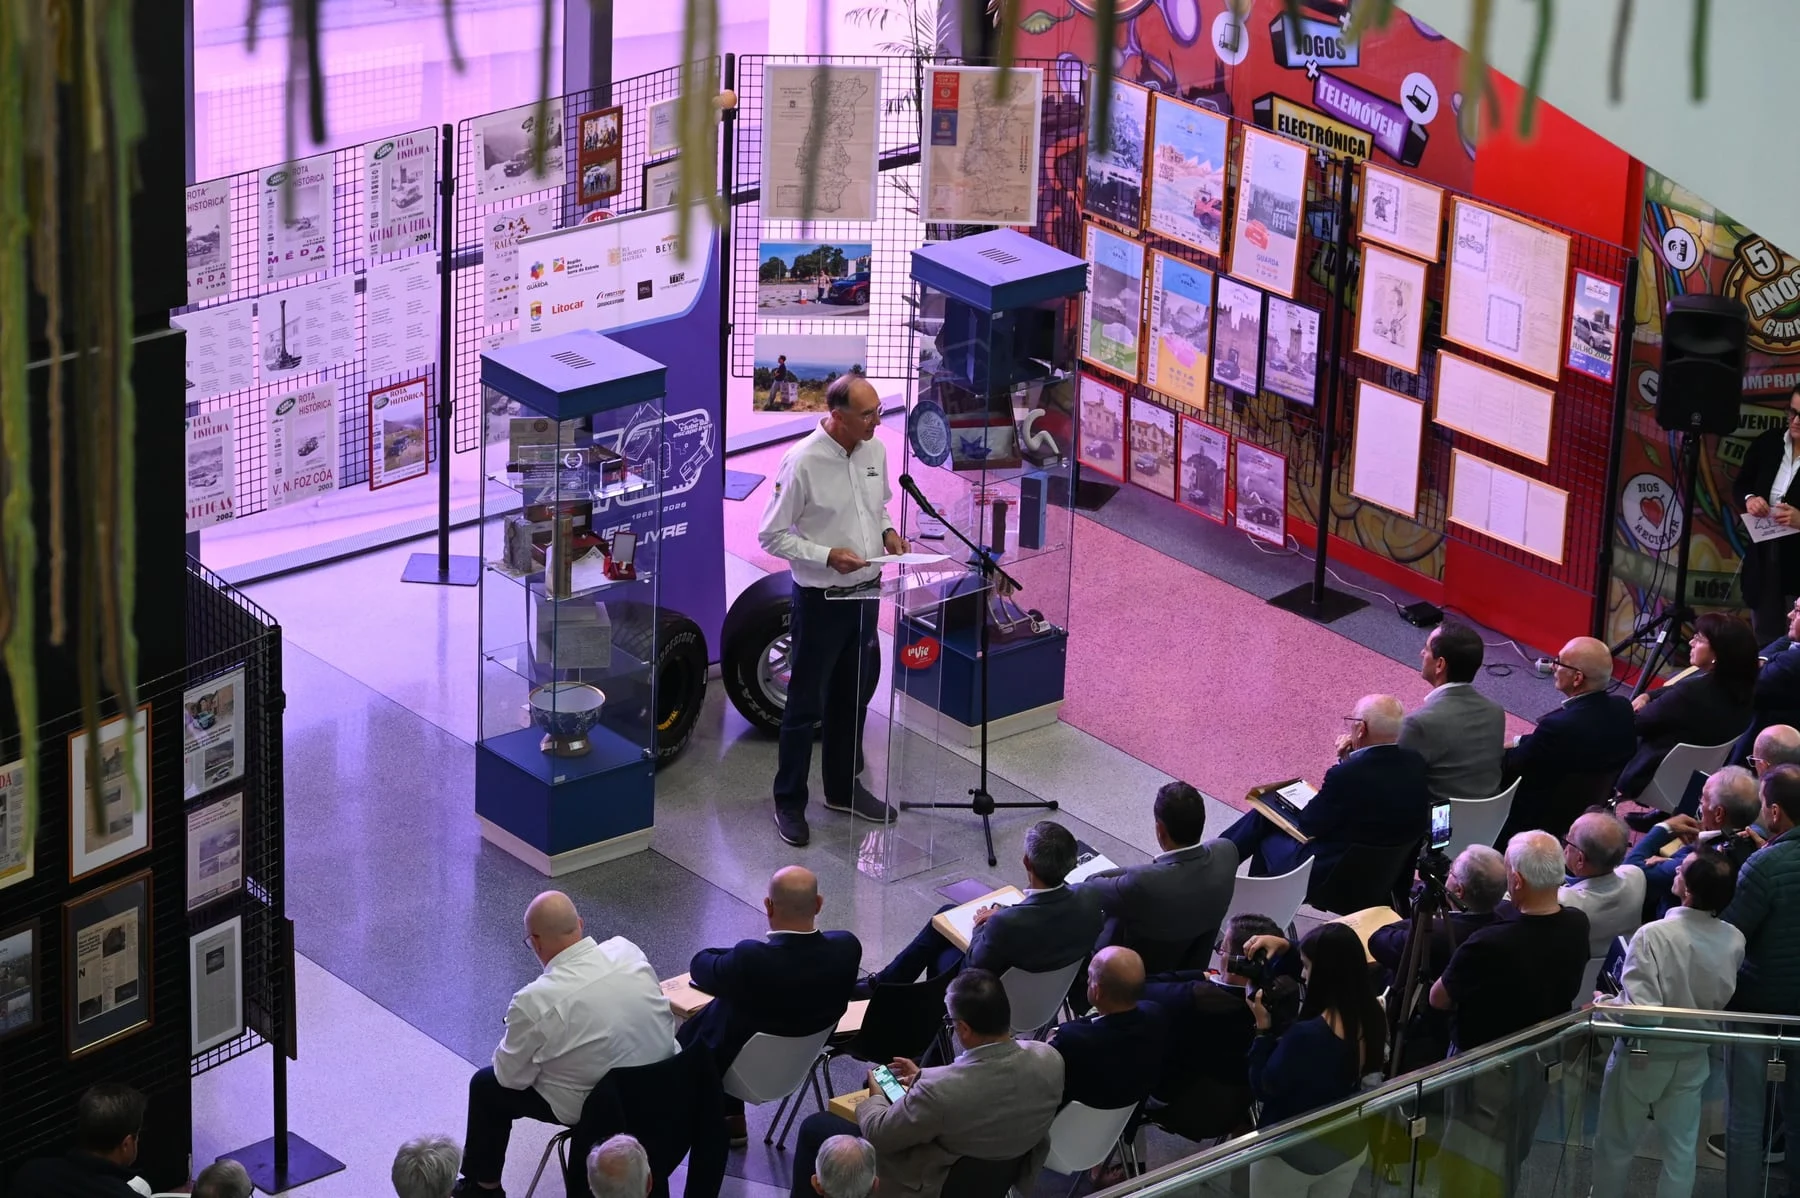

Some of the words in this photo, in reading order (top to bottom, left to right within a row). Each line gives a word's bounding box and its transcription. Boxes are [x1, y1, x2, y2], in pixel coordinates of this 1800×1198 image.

[1296, 33, 1347, 60] JOGOS
[1319, 77, 1403, 143] TELEMÓVEIS
[1278, 113, 1367, 158] ELECTRÓNICA
[292, 165, 309, 176] ROTA
[187, 187, 207, 201] ROTA
[415, 231, 432, 242] 2001
[1746, 240, 1777, 276] 5
[527, 281, 549, 291] GUARDA
[552, 300, 584, 314] Litocar
[298, 392, 316, 404] ROTA
[390, 388, 407, 398] ROTA
[294, 475, 312, 490] FOZ
[318, 482, 334, 492] 2003
[216, 511, 234, 522] 2002
[78, 967, 86, 979] N
